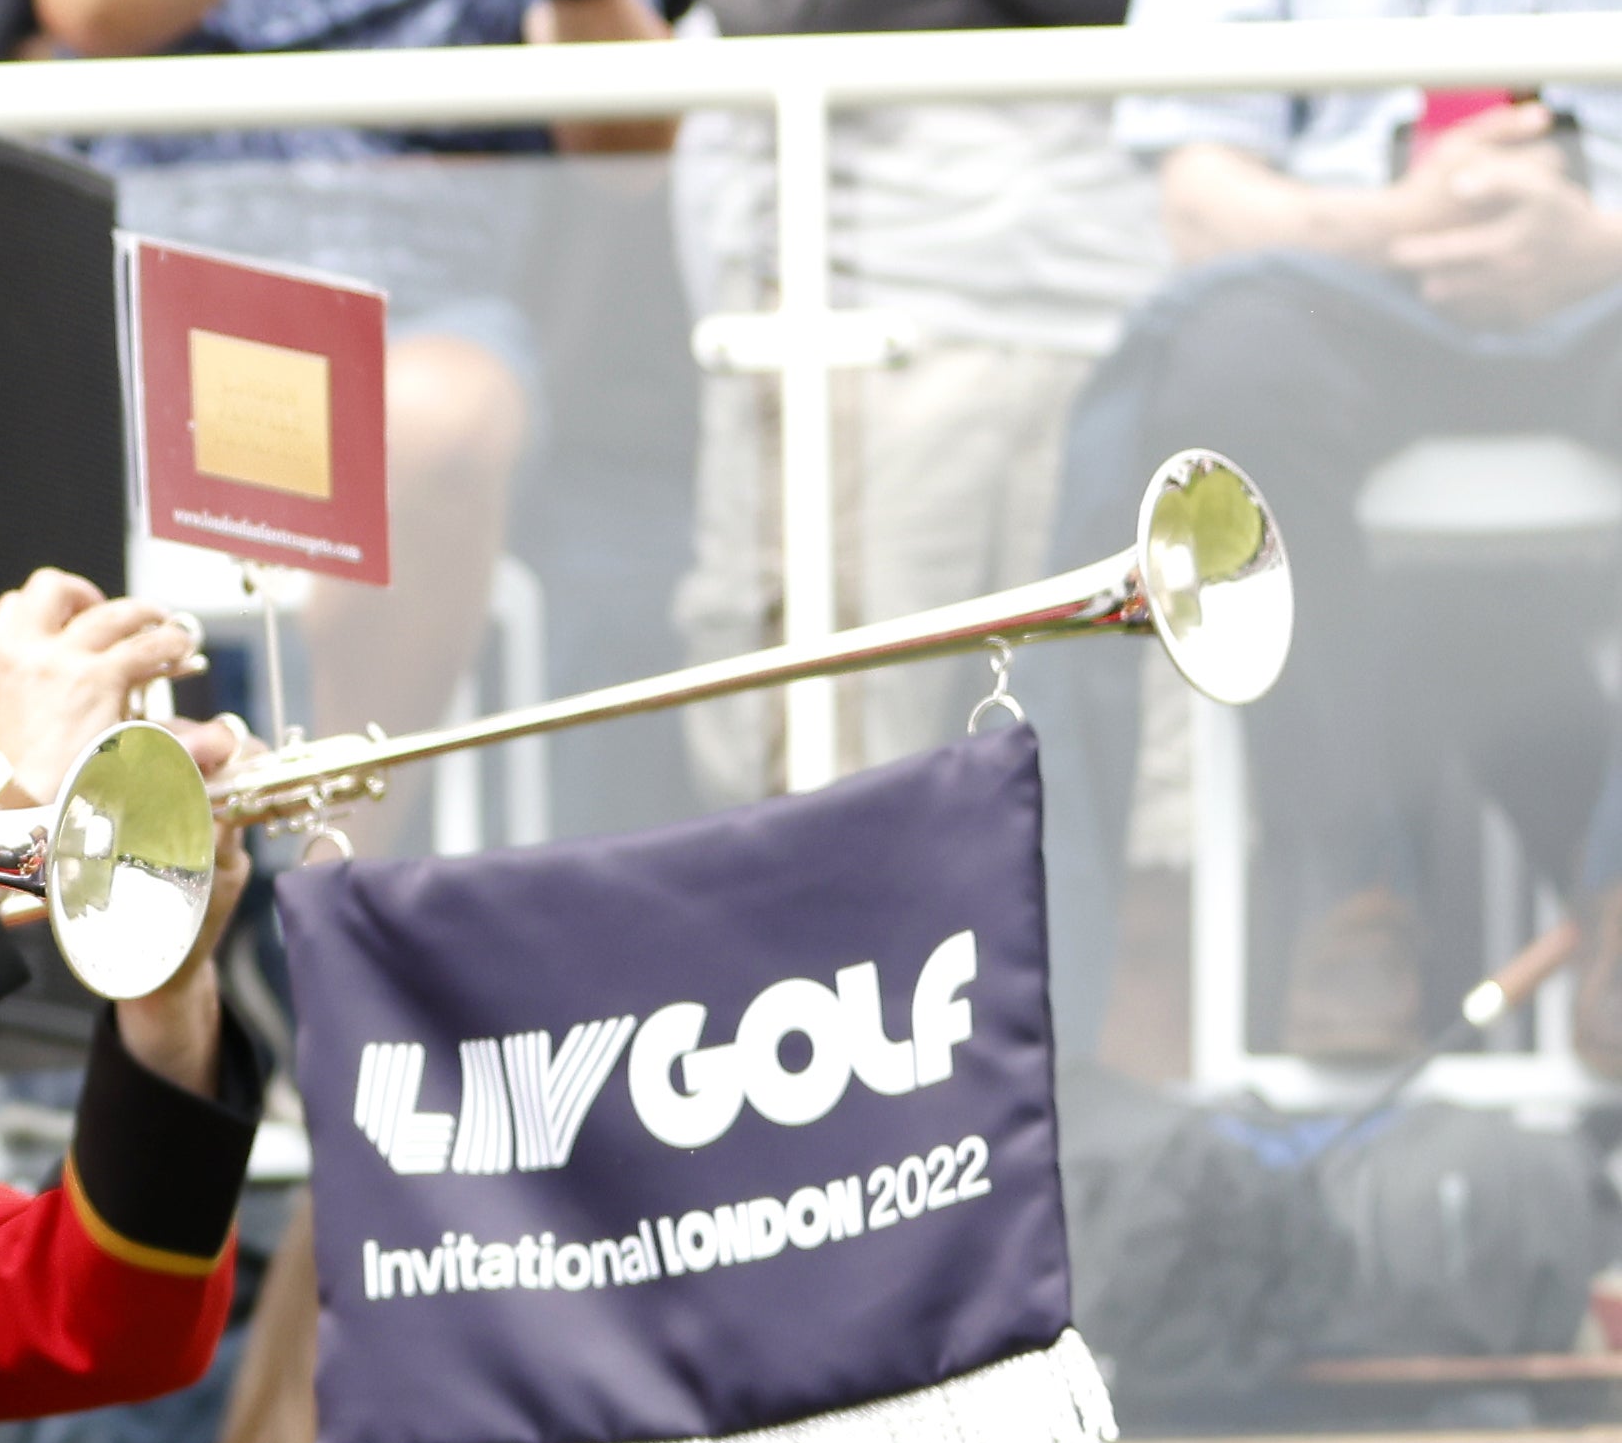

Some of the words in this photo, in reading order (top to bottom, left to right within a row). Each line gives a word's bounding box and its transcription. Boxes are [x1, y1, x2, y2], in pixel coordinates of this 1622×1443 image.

[354, 1014, 636, 1175] LIV
[628, 929, 978, 1148] GOLF
[363, 1218, 660, 1300] Invitational
[658, 1174, 864, 1276] LONDON
[866, 1135, 992, 1231] 2022
